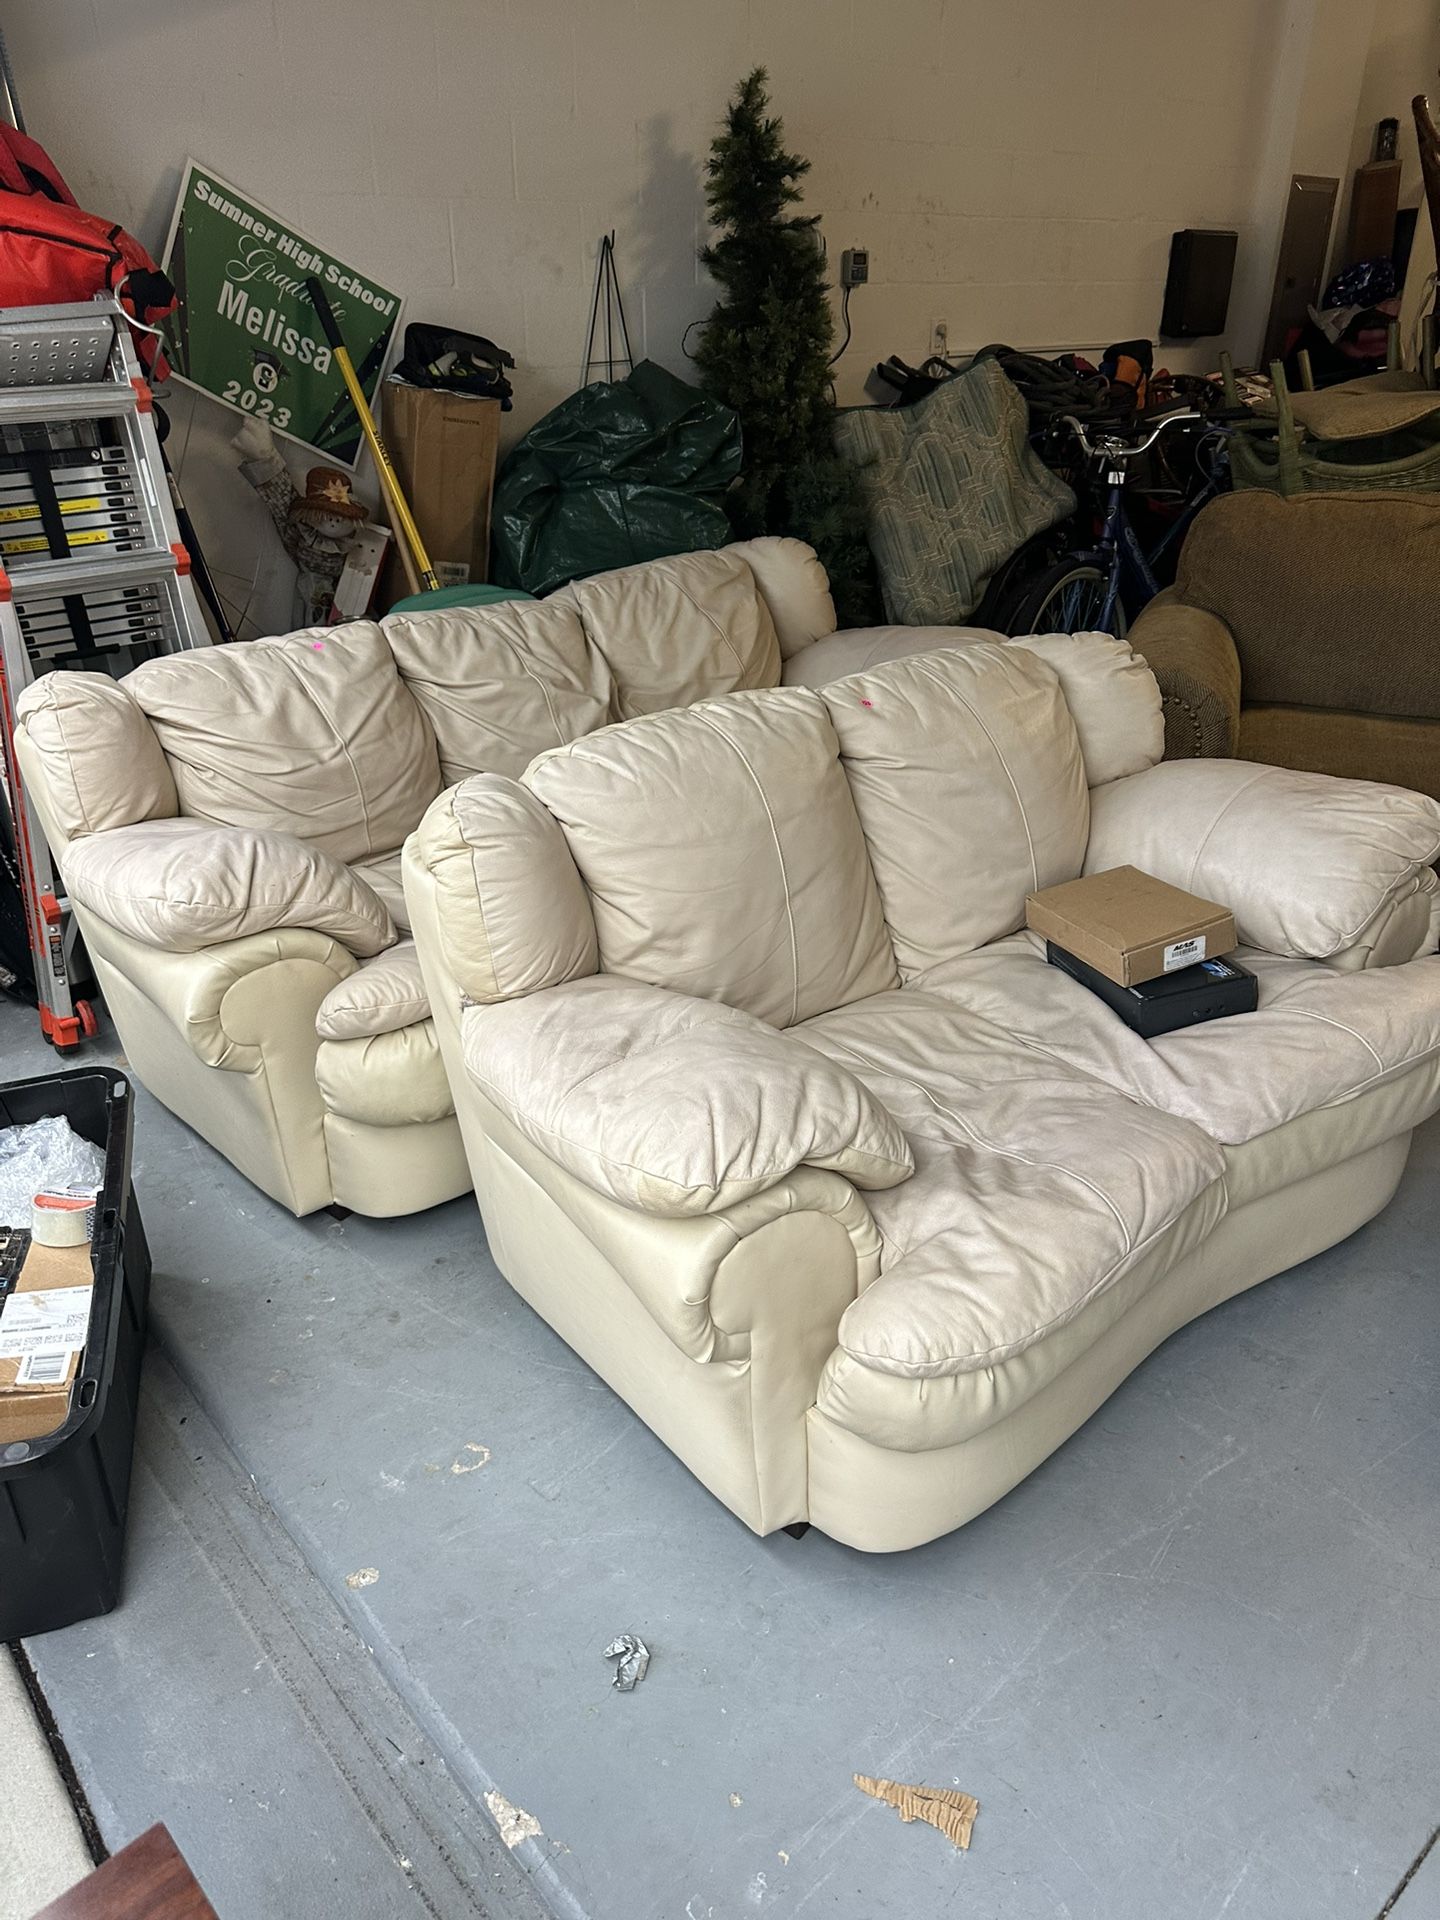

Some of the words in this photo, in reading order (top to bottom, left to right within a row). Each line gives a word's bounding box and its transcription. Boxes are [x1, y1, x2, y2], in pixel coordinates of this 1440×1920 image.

[194, 179, 277, 243] Sumner
[276, 234, 323, 275] High
[324, 264, 395, 316] School
[225, 234, 347, 322] Gradute
[216, 280, 333, 374] Melissa
[222, 380, 292, 428] 2023
[372, 429, 392, 466] STANLEY
